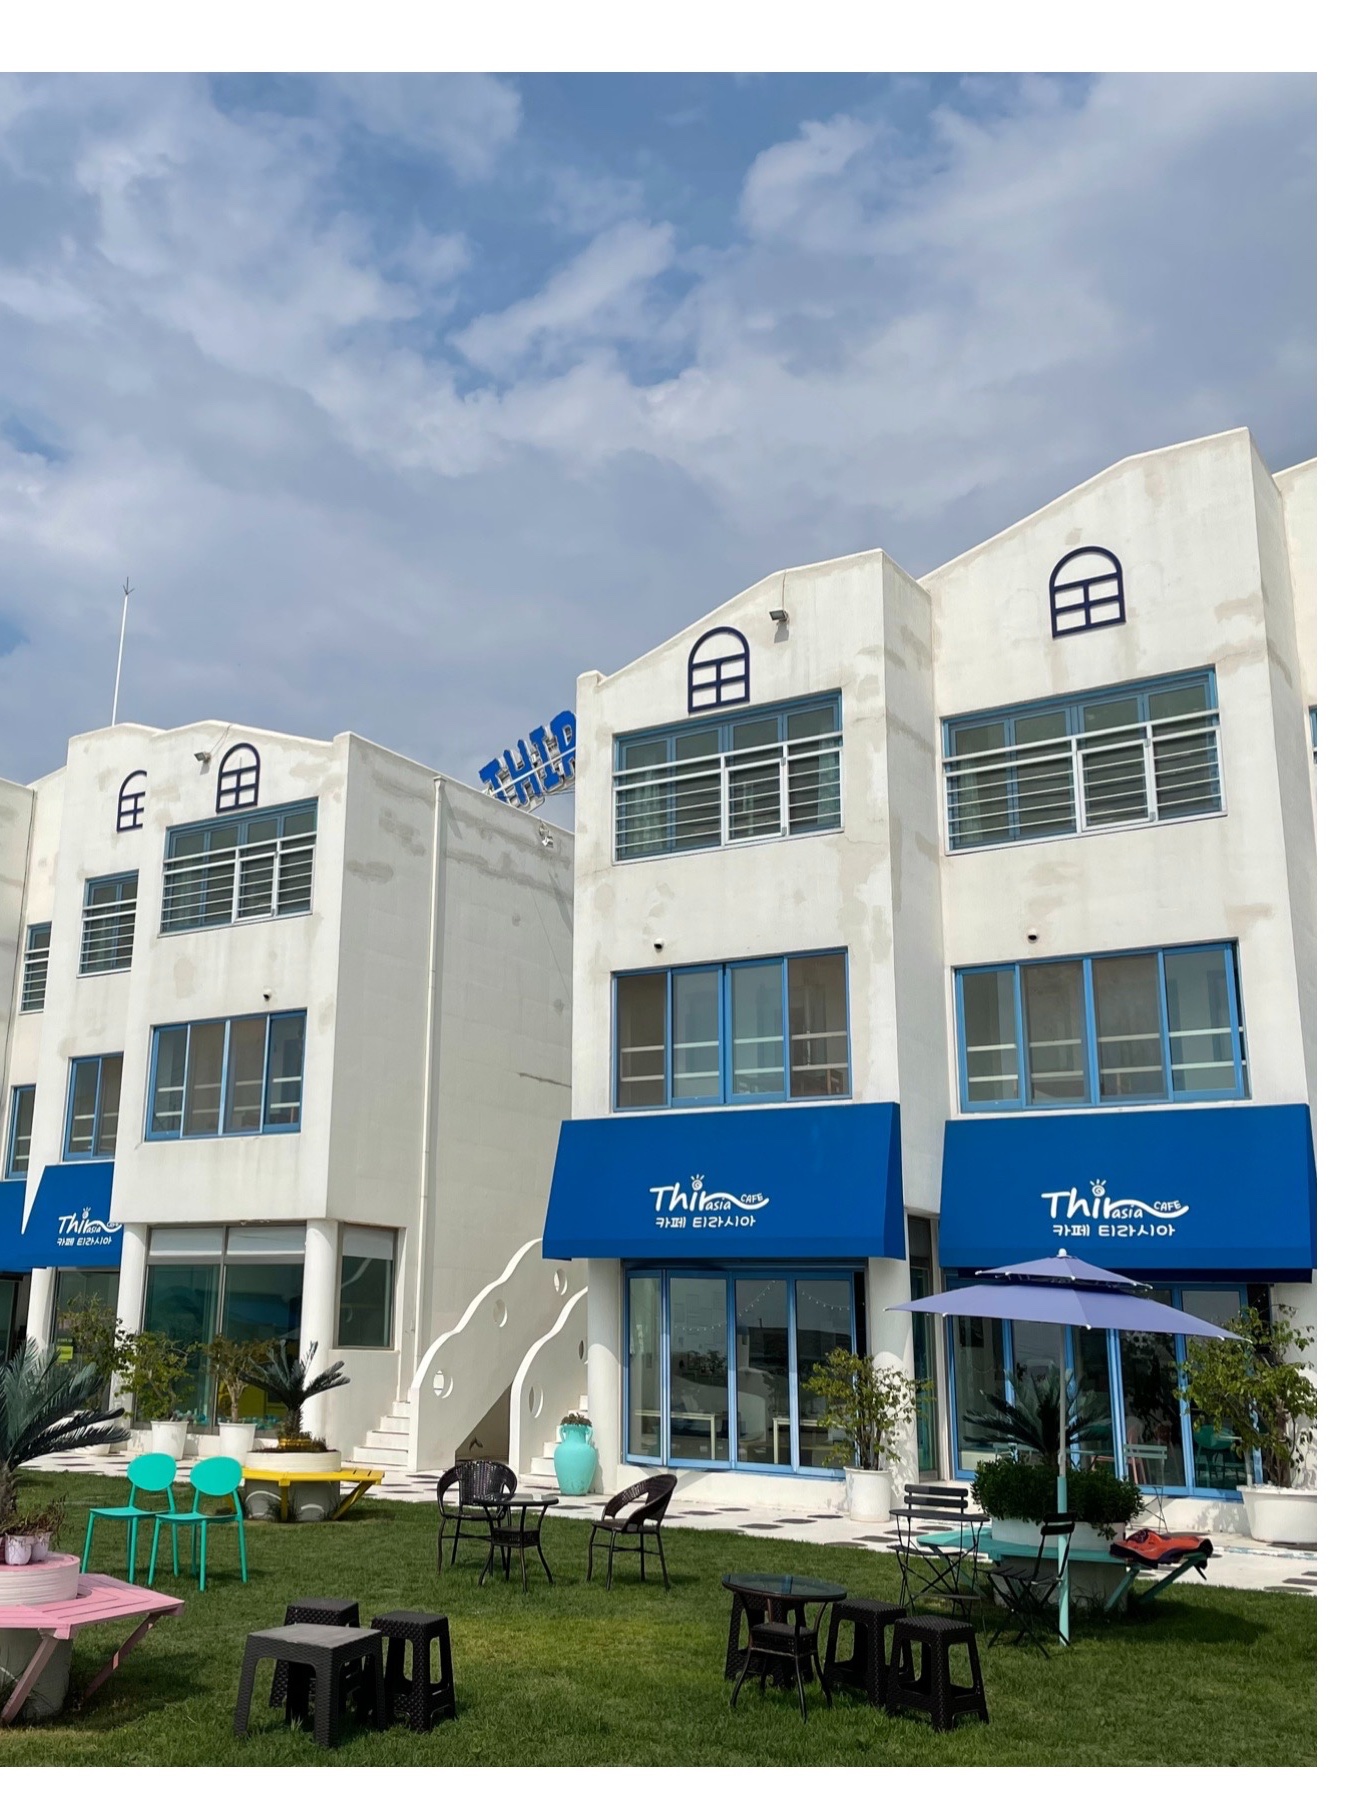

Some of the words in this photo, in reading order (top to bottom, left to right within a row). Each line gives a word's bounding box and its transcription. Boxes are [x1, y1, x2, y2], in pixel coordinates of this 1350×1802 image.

[1153, 1200, 1182, 1212] CAFE
[655, 1216, 686, 1229] 카페
[692, 1215, 756, 1229] 티라시아
[1052, 1224, 1090, 1237] 카페
[1098, 1223, 1176, 1237] 티라시아
[56, 1237, 75, 1247] 카페
[77, 1236, 112, 1247] 티라시아
